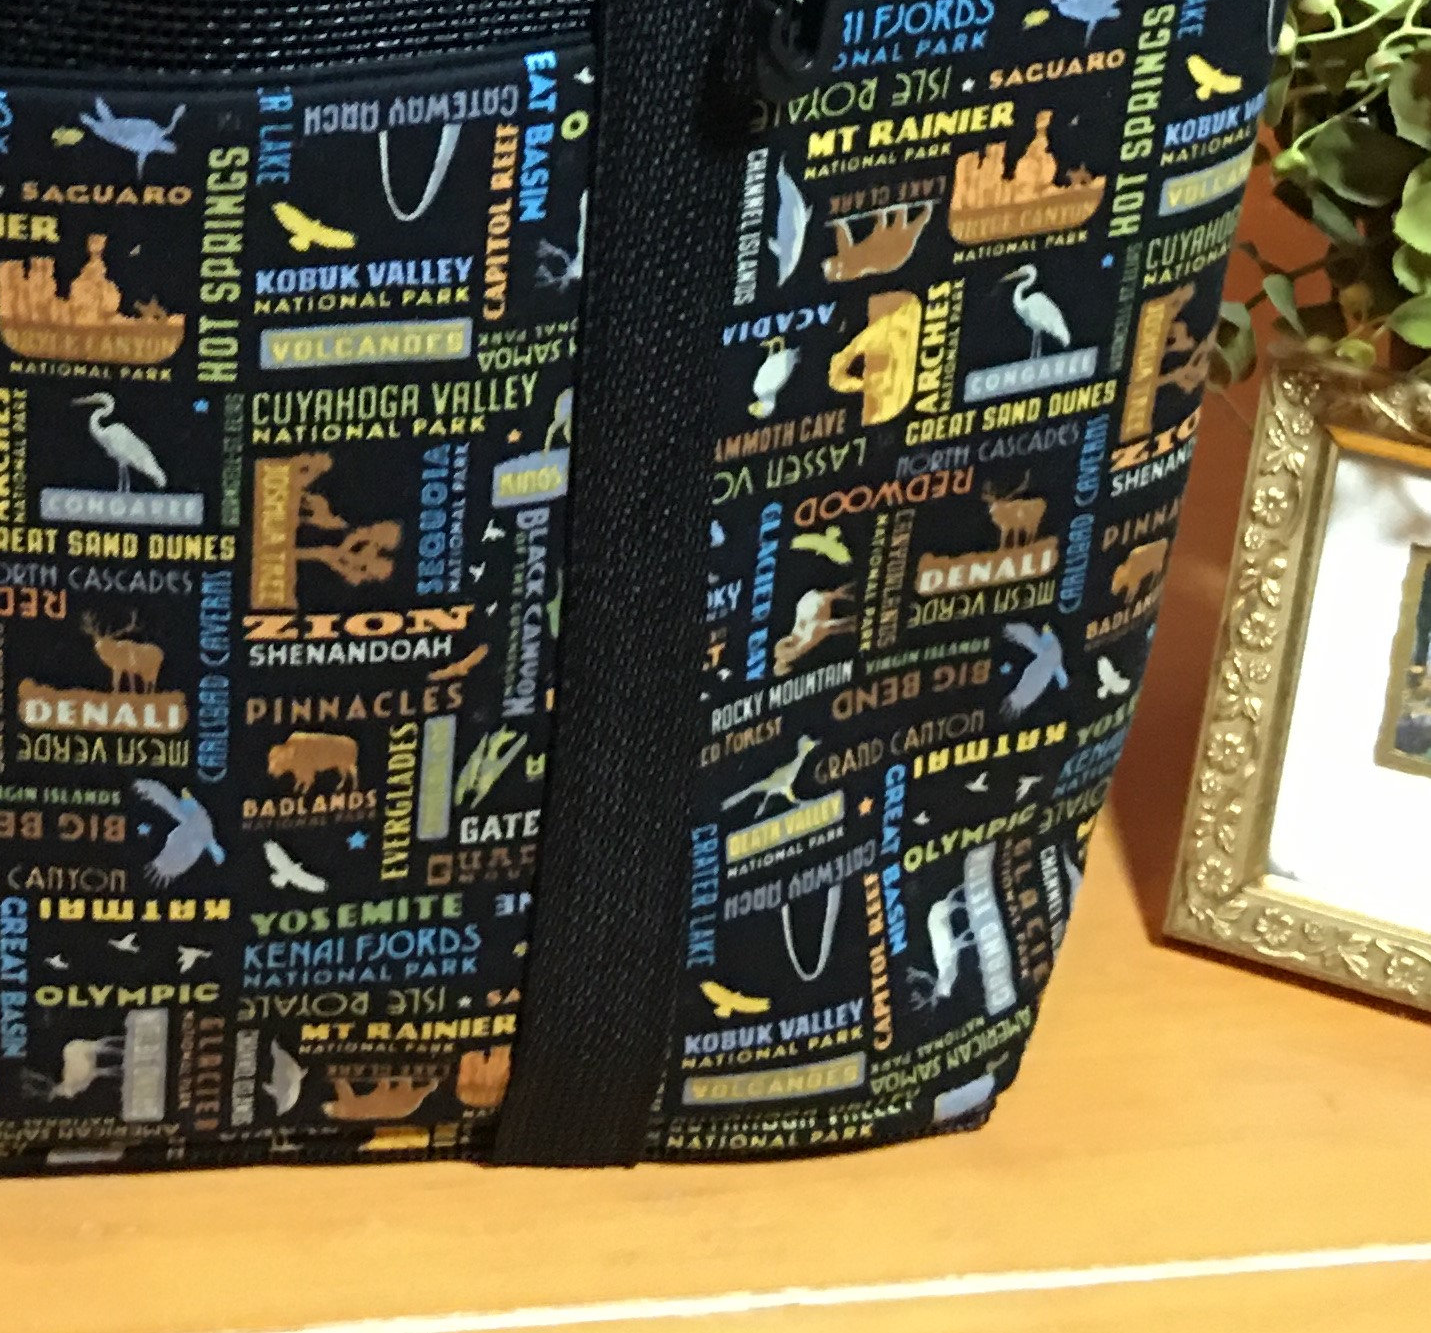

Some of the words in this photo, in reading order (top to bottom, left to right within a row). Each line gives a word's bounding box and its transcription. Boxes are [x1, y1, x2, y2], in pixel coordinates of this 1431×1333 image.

[917, 28, 987, 59] PARK
[1121, 3, 1176, 164] SPRINGS
[807, 123, 858, 159] MT
[868, 101, 1016, 148] RAINIER
[1163, 114, 1240, 148] KOBUK
[519, 122, 555, 223] BASIN
[803, 152, 898, 180] NATIONAL
[904, 141, 952, 161] PARK
[201, 146, 250, 305] SPRINGS
[1108, 172, 1149, 239] HOT
[951, 241, 1044, 266] NATIONAL
[1045, 232, 1088, 250] PARK
[255, 263, 360, 295] KOBUK
[368, 255, 474, 287] VALLEY
[255, 290, 392, 316] NATIONAL
[401, 286, 471, 307] PARK
[722, 301, 837, 345] ACADIA
[198, 317, 241, 384] HOT
[272, 329, 465, 365] VOLCANOES
[915, 280, 953, 417] ARCHES
[432, 373, 539, 417] VALLEY
[904, 409, 978, 447] GREAT
[982, 396, 1042, 431] SAND
[1047, 378, 1117, 419] DUNES
[252, 422, 402, 445] NATIONAL
[413, 415, 486, 438] PARK
[793, 465, 974, 529] REDWOOD
[68, 532, 138, 559] SAND
[149, 534, 236, 562] DUNES
[917, 549, 1054, 595] DENALI
[241, 604, 475, 643] ZION
[247, 634, 452, 668] SHENANDOAH
[711, 688, 764, 736] ROCKY
[769, 660, 853, 716] MOUNTAIN
[831, 672, 921, 721] BEND
[930, 660, 992, 692] BIG
[23, 698, 181, 730] DENALI
[245, 683, 465, 726] PINNACLES
[913, 721, 1067, 779] KATMAI
[241, 788, 378, 818] BADLANDS
[380, 720, 421, 883] EVERGLADES
[56, 812, 126, 842] BIG
[903, 803, 1038, 873] OLYMPIC
[726, 841, 804, 879] NATIONAL
[808, 824, 846, 852] PARK
[38, 897, 232, 922] KATMAI
[250, 891, 464, 936] YOSEMITE
[881, 860, 909, 957] BASIN
[0, 896, 28, 985] GREAT
[243, 936, 344, 969] KENAI
[354, 925, 482, 961] FJORDS
[243, 963, 392, 988] NATIONAL
[403, 957, 478, 980] PARK
[34, 983, 221, 1008] OLYMPIC
[0, 991, 28, 1058] BASIN
[300, 1022, 356, 1042] MT
[367, 1013, 517, 1040] RAINIER
[684, 1024, 773, 1056] KOBUK
[779, 997, 865, 1041] VALLEY
[680, 1040, 801, 1071] NATIONAL
[807, 1026, 864, 1053] PARK
